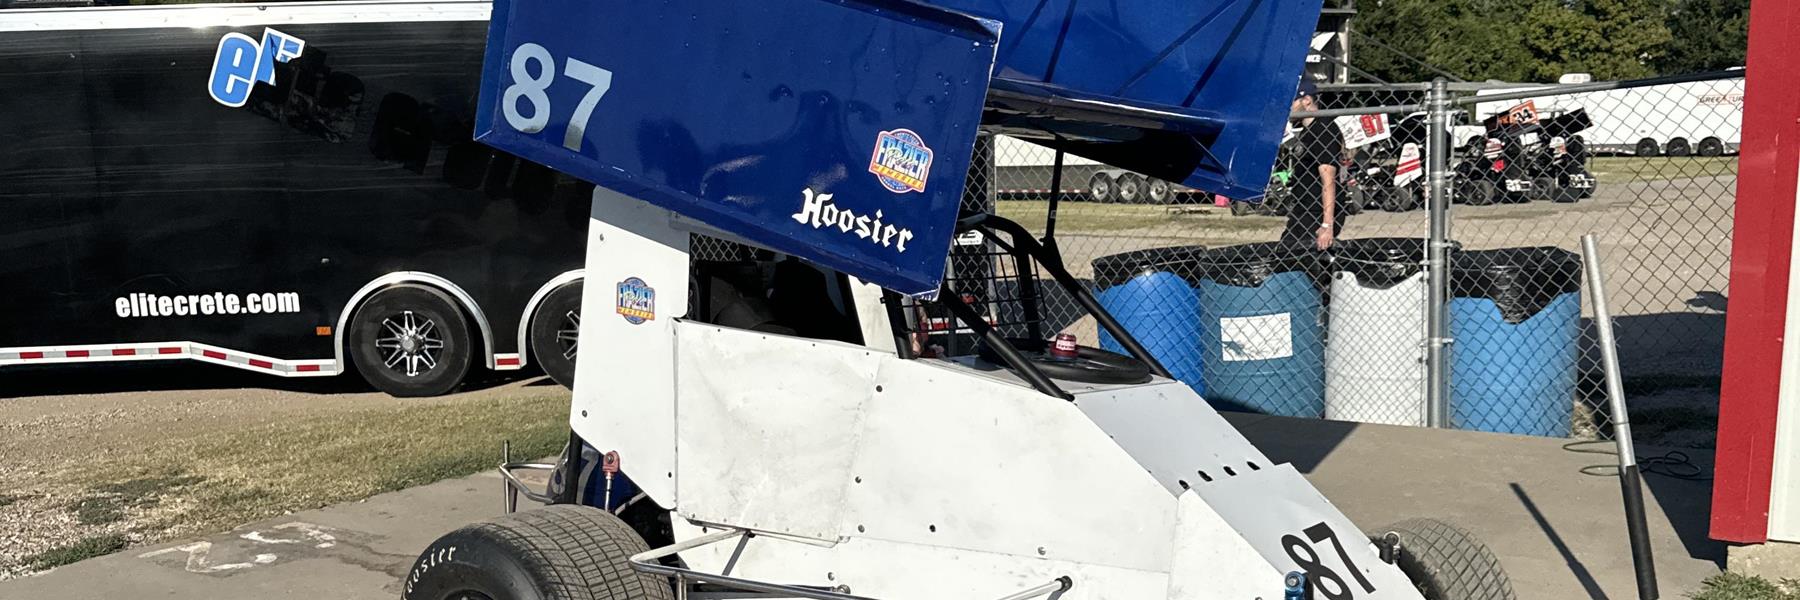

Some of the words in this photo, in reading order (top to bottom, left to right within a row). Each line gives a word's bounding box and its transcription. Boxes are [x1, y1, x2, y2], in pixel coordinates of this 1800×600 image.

[503, 42, 612, 152] 87
[875, 136, 929, 181] FRAZIER
[792, 188, 914, 253] Hoosier
[115, 292, 300, 317] elitecrete.com
[402, 546, 456, 600] oosier
[1281, 521, 1376, 600] 87
